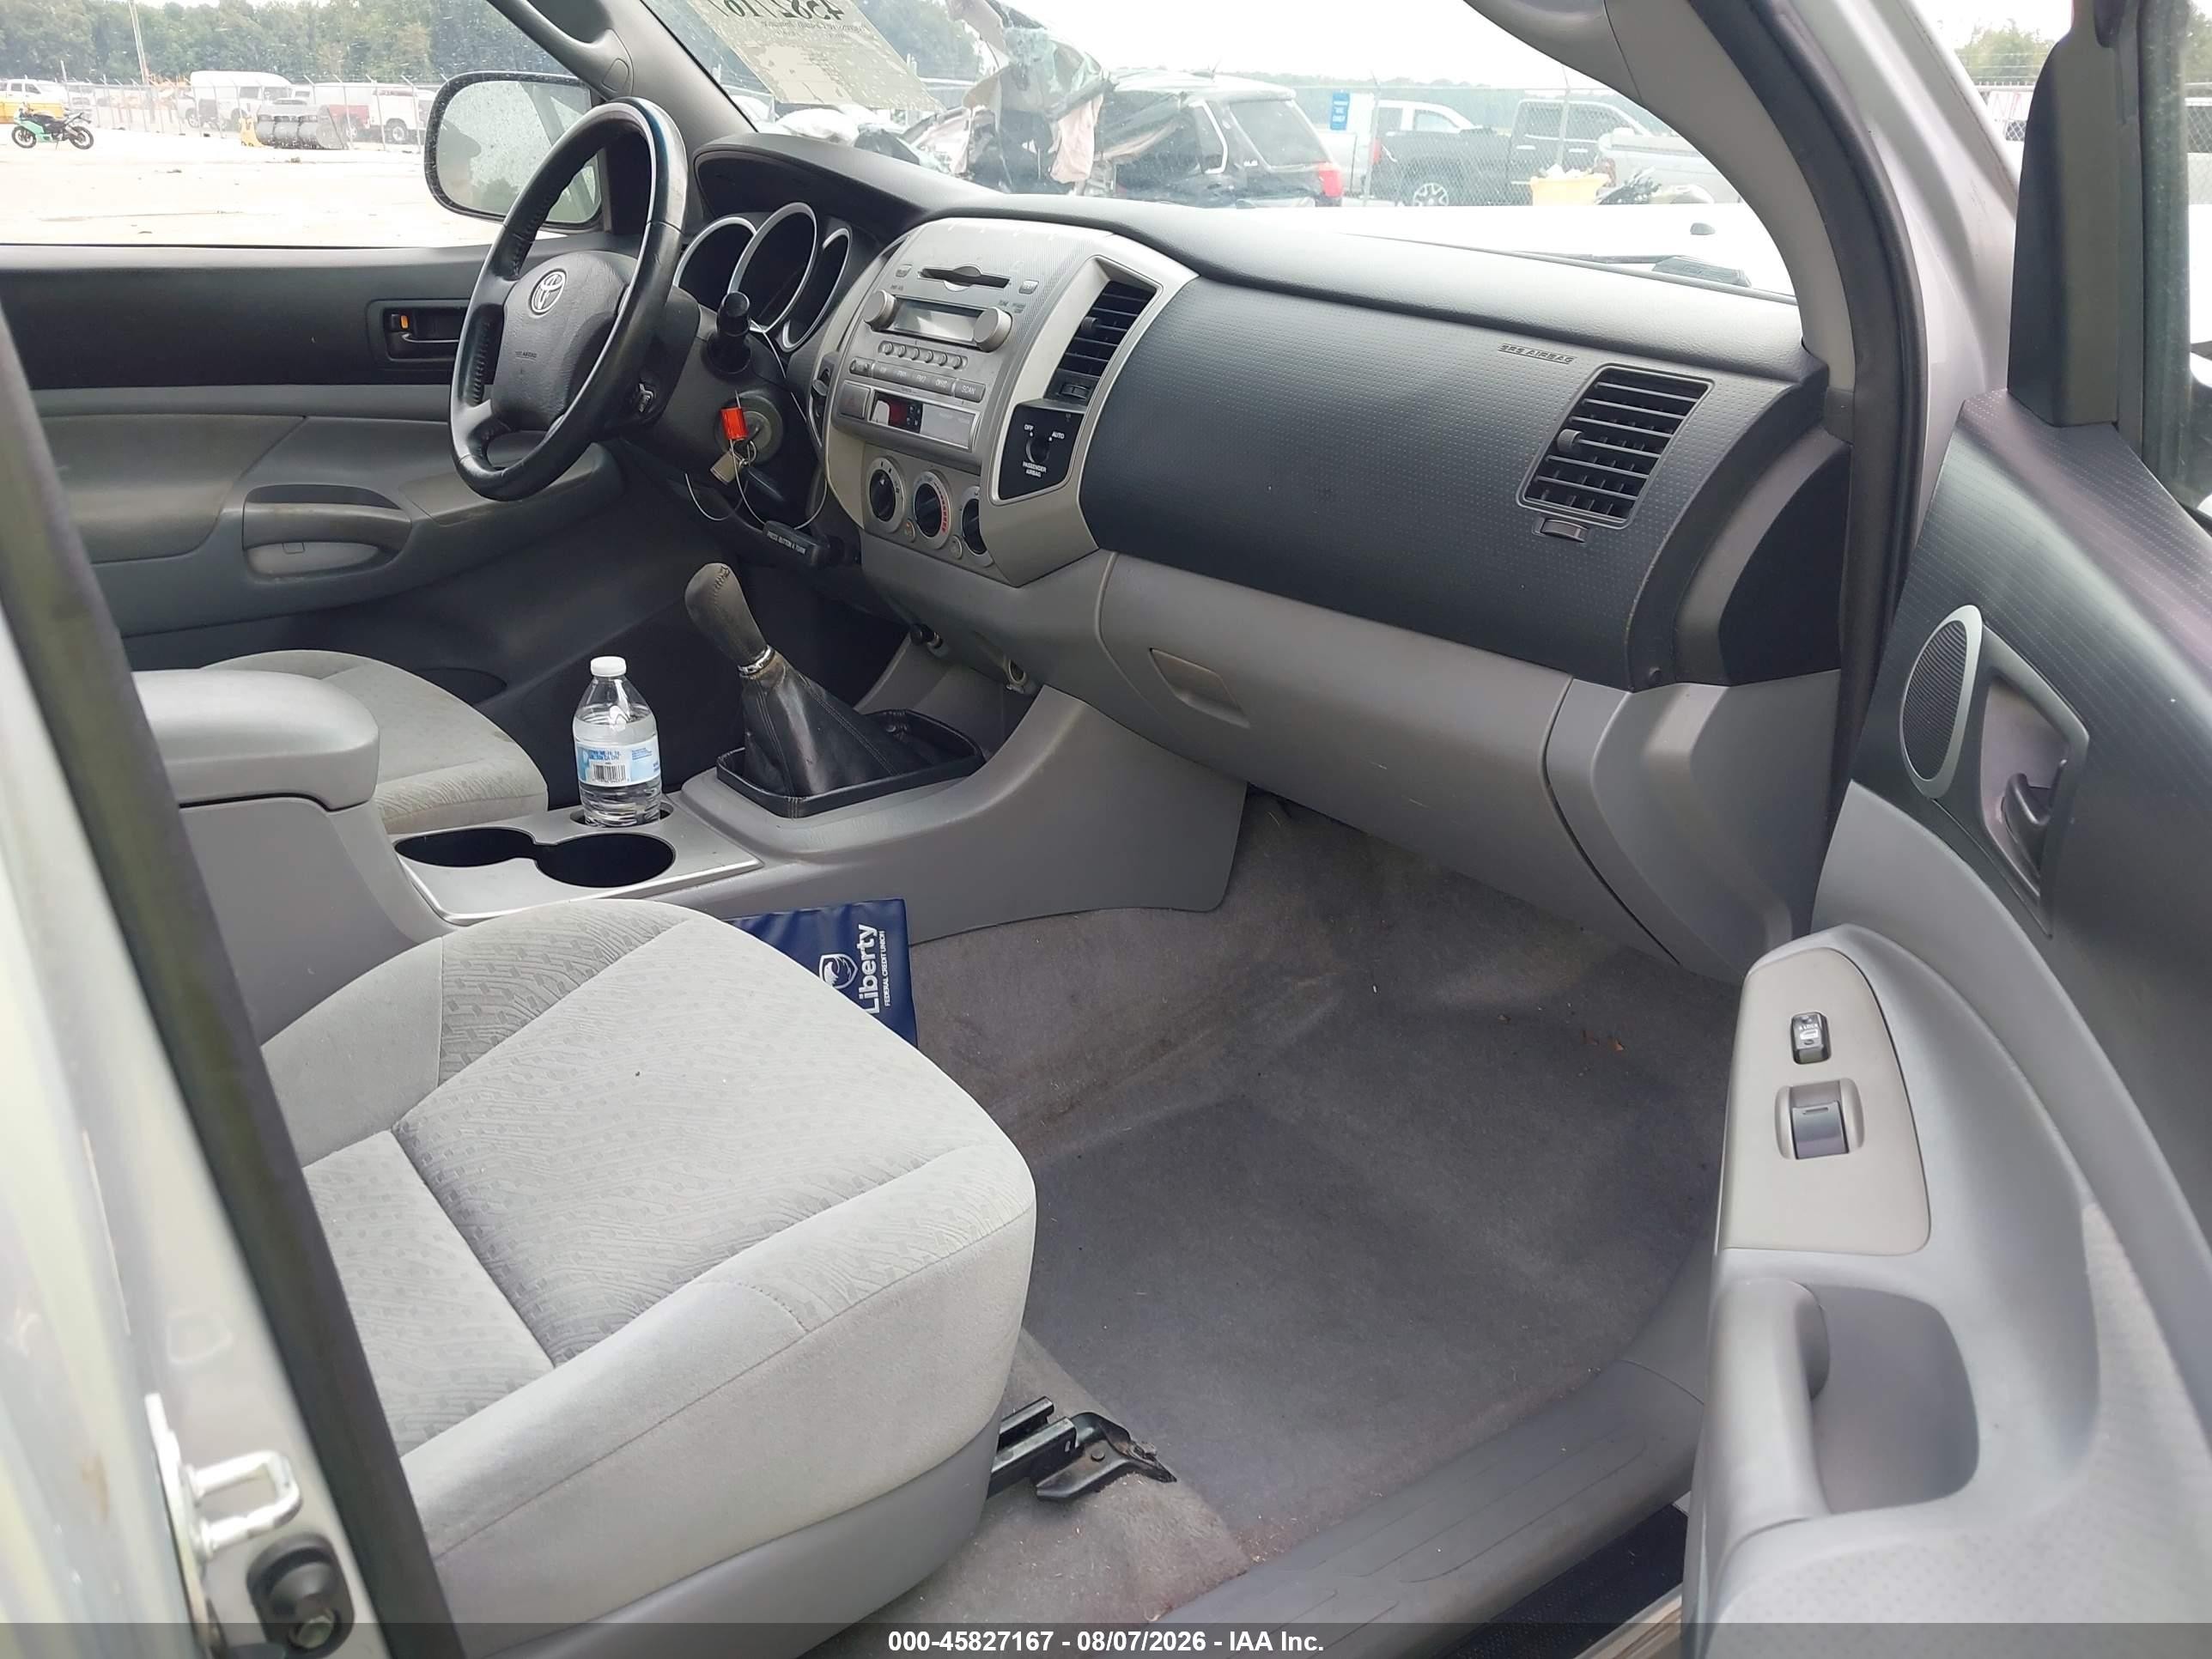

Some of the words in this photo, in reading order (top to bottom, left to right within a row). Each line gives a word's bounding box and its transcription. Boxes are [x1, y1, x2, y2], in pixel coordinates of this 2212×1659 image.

[1499, 344, 1525, 354] SRS
[1525, 349, 1575, 363] AIRBAG
[961, 385, 976, 395] SCAN
[1052, 430, 1065, 440] AUTO
[878, 930, 887, 954] UNION
[857, 923, 880, 1014] Liberty
[880, 954, 889, 976] CREDIT
[882, 975, 891, 1007] FEDERAL
